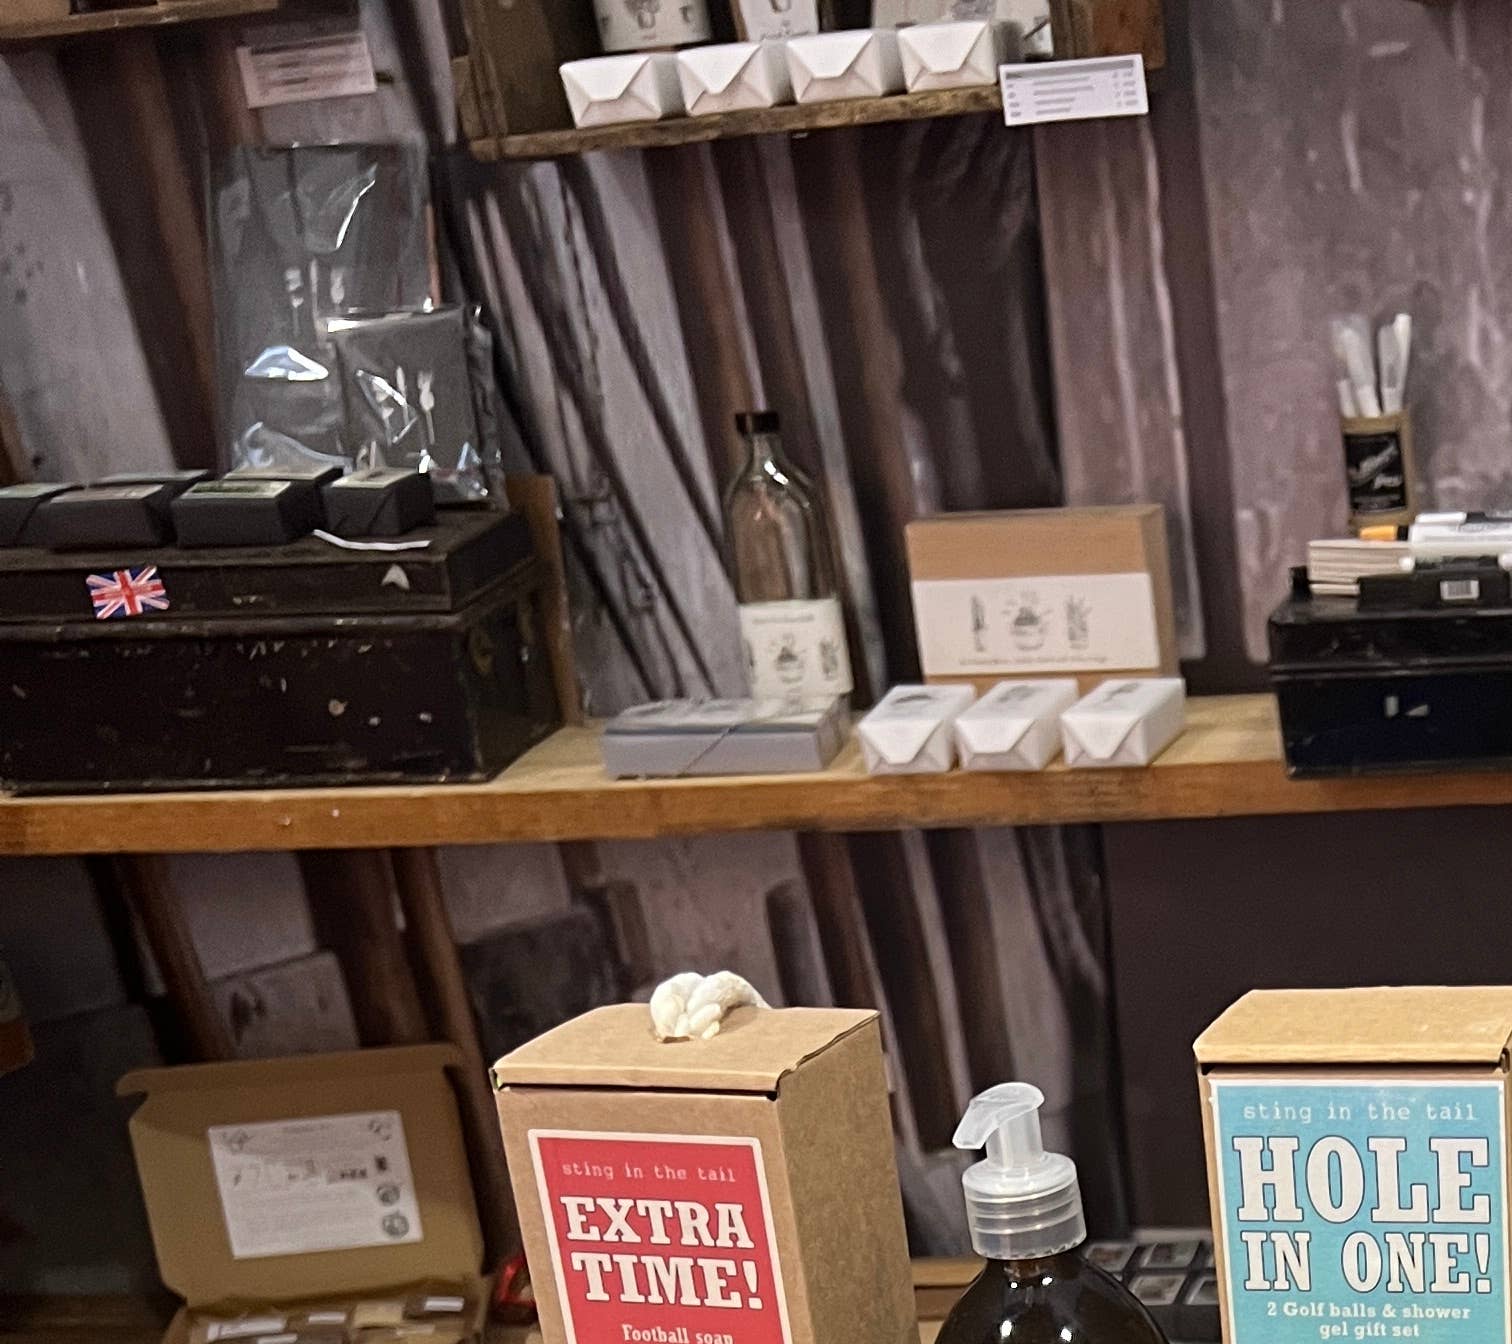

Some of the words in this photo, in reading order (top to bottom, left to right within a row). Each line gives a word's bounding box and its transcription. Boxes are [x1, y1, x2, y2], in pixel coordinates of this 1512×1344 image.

[1243, 1105, 1311, 1124] sting
[1328, 1104, 1351, 1119] in
[1368, 1102, 1411, 1121] the
[1427, 1103, 1477, 1121] tail
[1232, 1135, 1491, 1224] HOLE
[560, 1196, 755, 1248] EXTRA
[571, 1252, 764, 1310] TIME!
[1241, 1231, 1311, 1292] IN
[1341, 1231, 1492, 1294] ONE!
[1267, 1303, 1276, 1316] 2
[1283, 1302, 1325, 1318] Golf
[1329, 1303, 1376, 1318] balls
[1382, 1304, 1396, 1318] &
[1402, 1305, 1471, 1319] shower
[622, 1325, 690, 1344] Football
[1319, 1322, 1348, 1339] gel
[1354, 1322, 1386, 1340] gift
[1392, 1324, 1420, 1337] set
